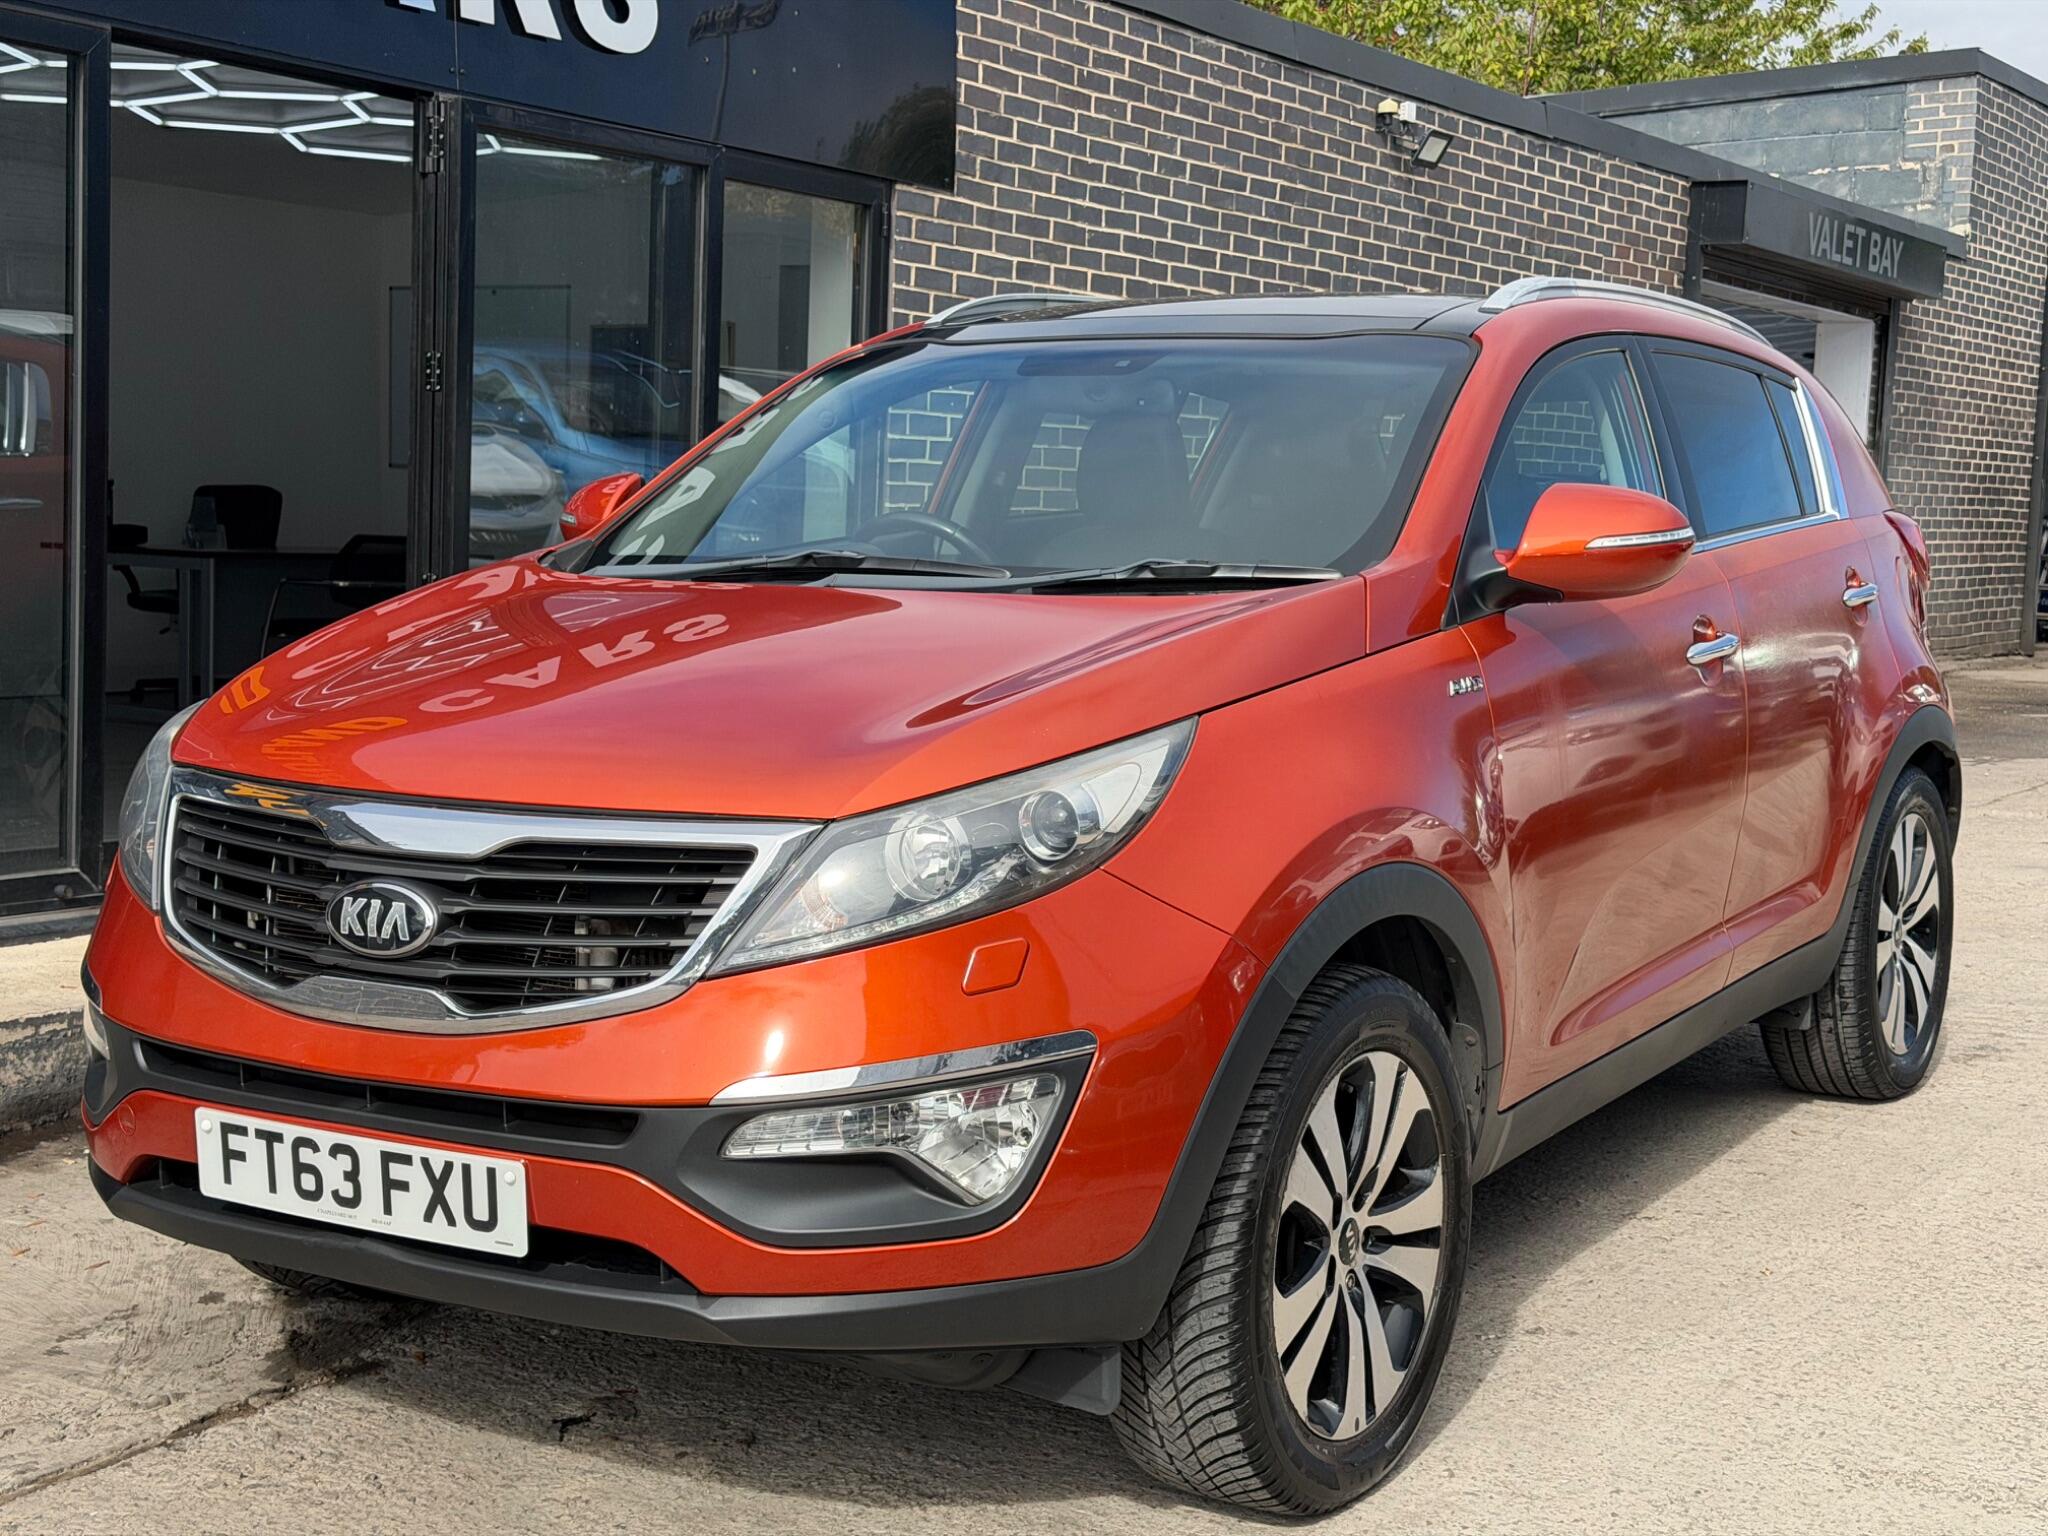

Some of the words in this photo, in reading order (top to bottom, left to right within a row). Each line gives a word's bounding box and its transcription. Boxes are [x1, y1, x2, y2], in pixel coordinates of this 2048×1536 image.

[1808, 211, 1867, 268] VALET
[1867, 231, 1905, 278] BAY
[339, 896, 410, 941] KIA
[219, 1121, 362, 1210] FT63
[379, 1149, 500, 1233] FXU
